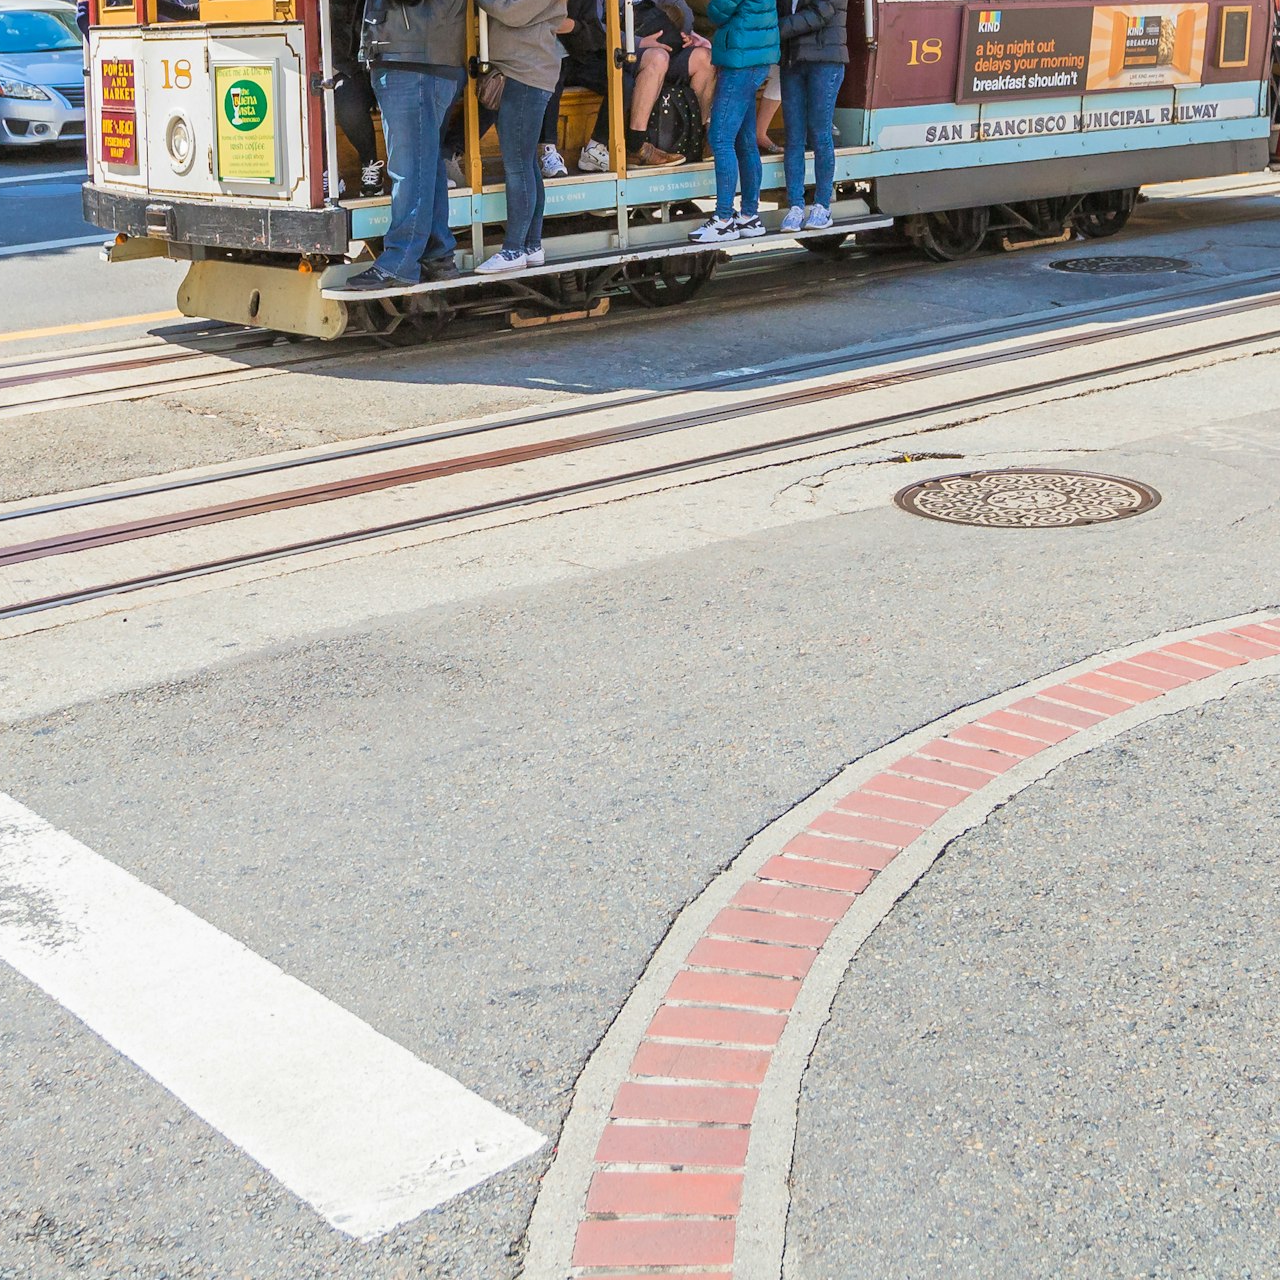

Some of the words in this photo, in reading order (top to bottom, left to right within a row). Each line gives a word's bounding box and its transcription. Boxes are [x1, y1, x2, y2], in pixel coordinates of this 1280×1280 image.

[978, 22, 1000, 33] KIND
[1127, 27, 1144, 36] KIND
[975, 44, 984, 55] a
[986, 40, 1004, 58] big
[1006, 39, 1035, 57] night
[1037, 39, 1055, 53] out
[1126, 38, 1158, 47] BREAKFAST
[907, 38, 942, 65] 18
[103, 64, 134, 76] POWELL
[975, 58, 1011, 74] delays
[1013, 59, 1040, 74] your
[1040, 53, 1085, 70] morning
[161, 59, 192, 89] 18
[972, 71, 1026, 92] breakfast
[1028, 70, 1078, 88] shouldn't
[111, 78, 127, 87] AND
[104, 87, 135, 100] MARKET
[925, 124, 963, 143] SAN
[970, 114, 1067, 139] FRANCISCO
[1073, 107, 1155, 132] MUNICIPAL
[1160, 103, 1220, 124] RAILWAY
